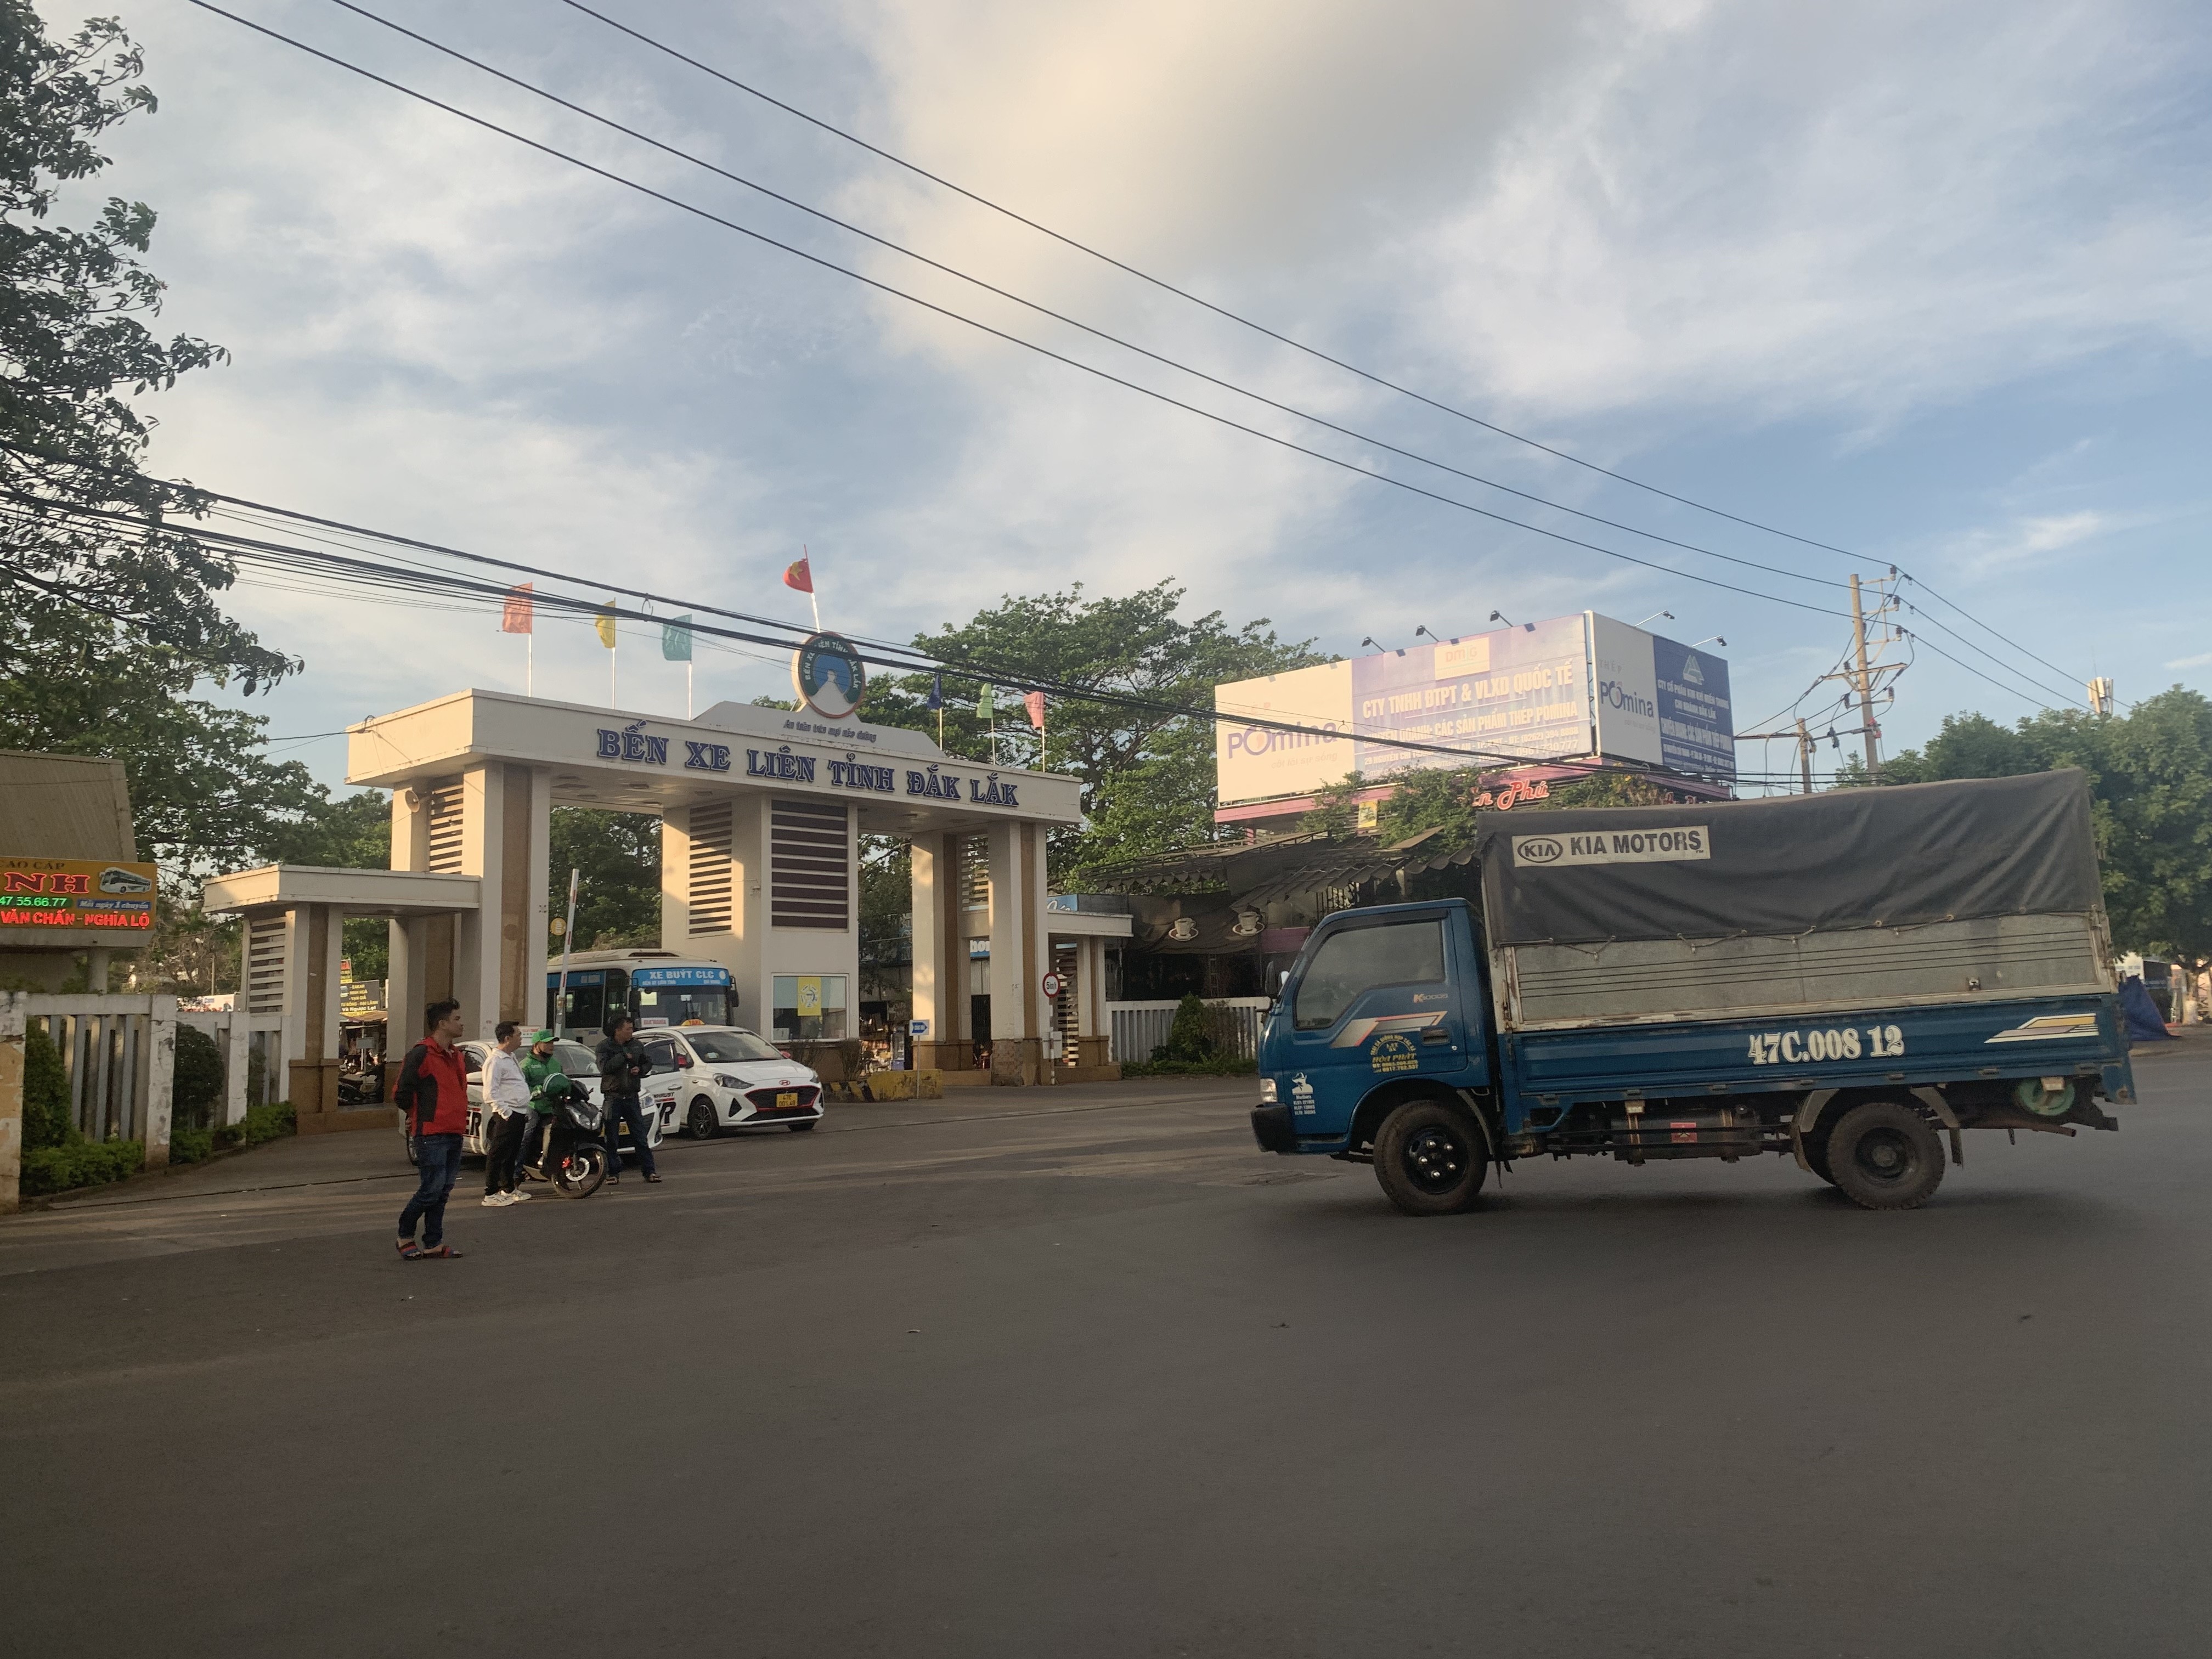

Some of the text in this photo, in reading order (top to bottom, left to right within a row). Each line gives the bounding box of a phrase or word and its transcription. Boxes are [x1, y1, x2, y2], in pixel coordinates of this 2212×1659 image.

[1363, 698, 1385, 719] CTY
[1389, 691, 1423, 714] TNHH
[1461, 683, 1472, 702] &
[1475, 676, 1510, 699] VLXD
[1513, 663, 1551, 695] QUỐC
[1555, 658, 1573, 686] TẾ
[1435, 719, 1454, 737] CÁC
[1456, 714, 1476, 735] SẢN
[1478, 708, 1507, 731] PHẨM
[1509, 706, 1534, 726] THÉP
[1536, 701, 1578, 722] POMINA
[597, 719, 1020, 807] BẾN XE LIÊN TỈNH ĐẮK LẮK
[1497, 778, 1550, 810] Phú
[1524, 845, 1558, 858] KIA
[1570, 835, 1607, 856] KIA
[1613, 830, 1702, 854] MOTORS
[16, 896, 67, 906] 55.66.77
[1, 909, 30, 924] VĂN
[32, 909, 75, 925] CHẤN
[84, 911, 128, 926] NGHĨA
[131, 912, 150, 930] LỘ
[650, 969, 714, 979] XE BUÝT CLC
[1748, 1024, 1905, 1065] 47C.008 12
